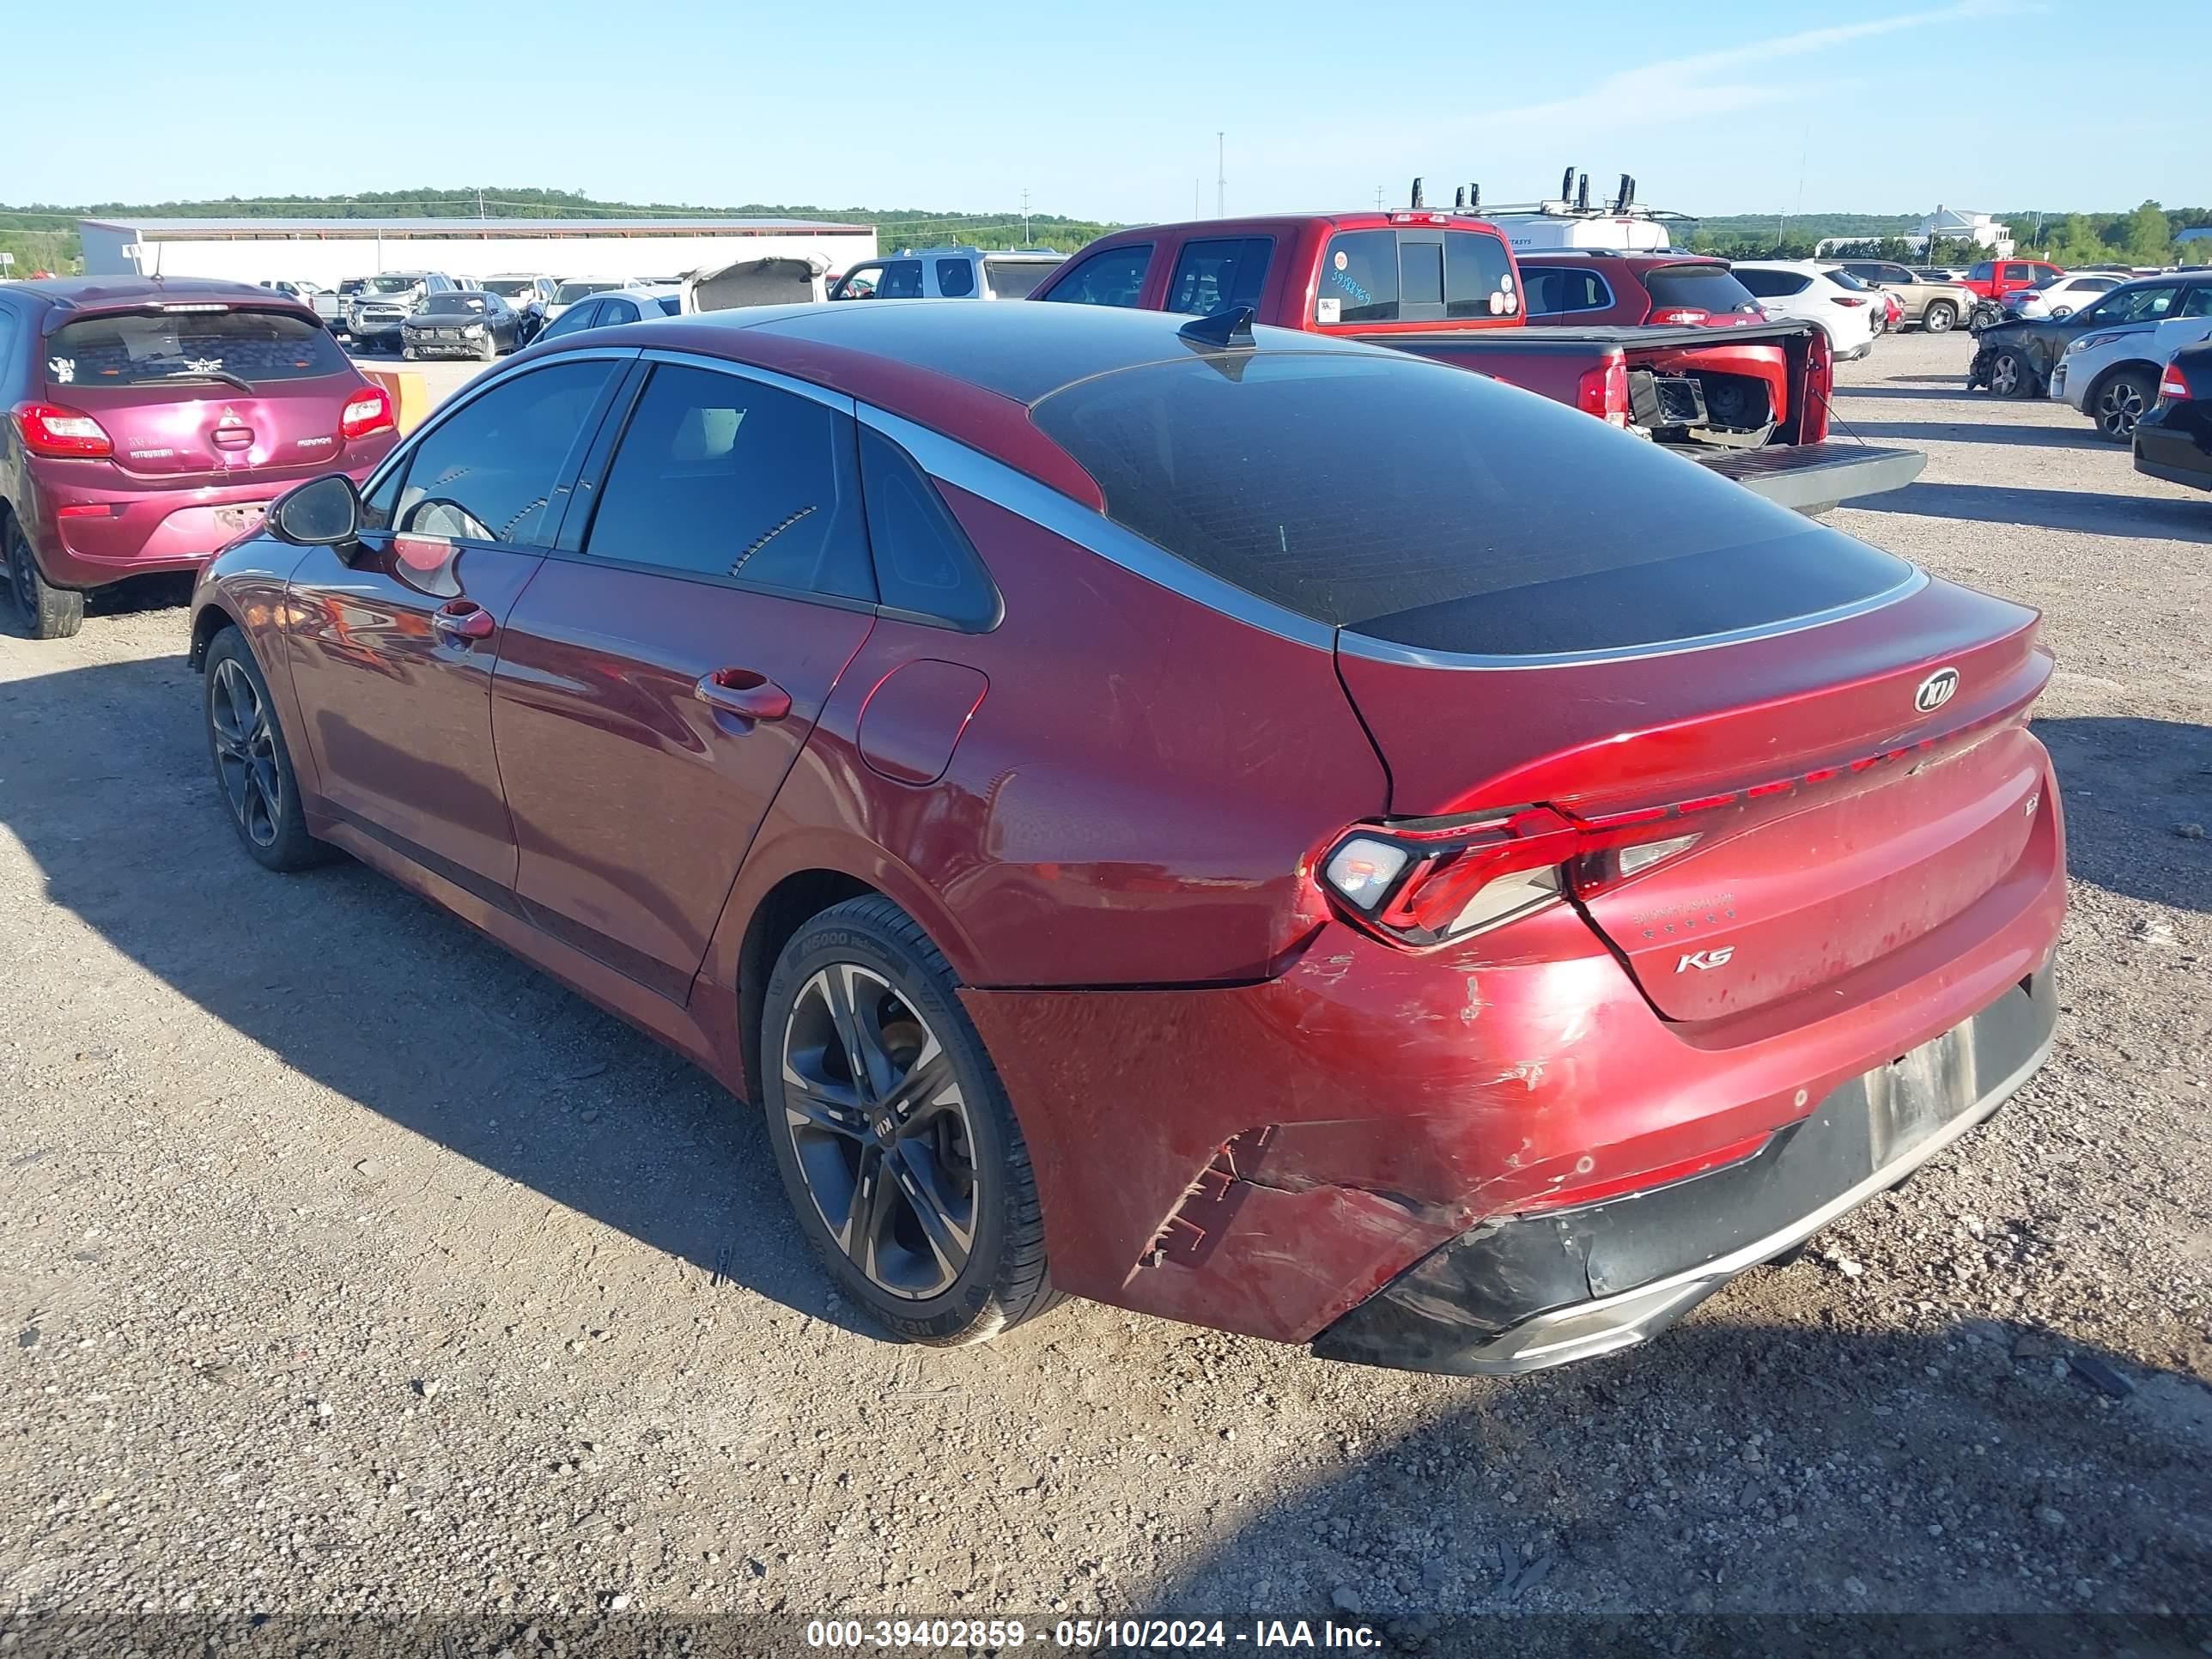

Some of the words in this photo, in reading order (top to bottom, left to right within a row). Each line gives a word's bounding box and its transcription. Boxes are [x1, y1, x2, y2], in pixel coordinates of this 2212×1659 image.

[130, 448, 173, 459] MITSUBISHI
[1923, 677, 1955, 707] KIA
[1674, 945, 1736, 974] K5
[874, 1116, 894, 1138] KIA
